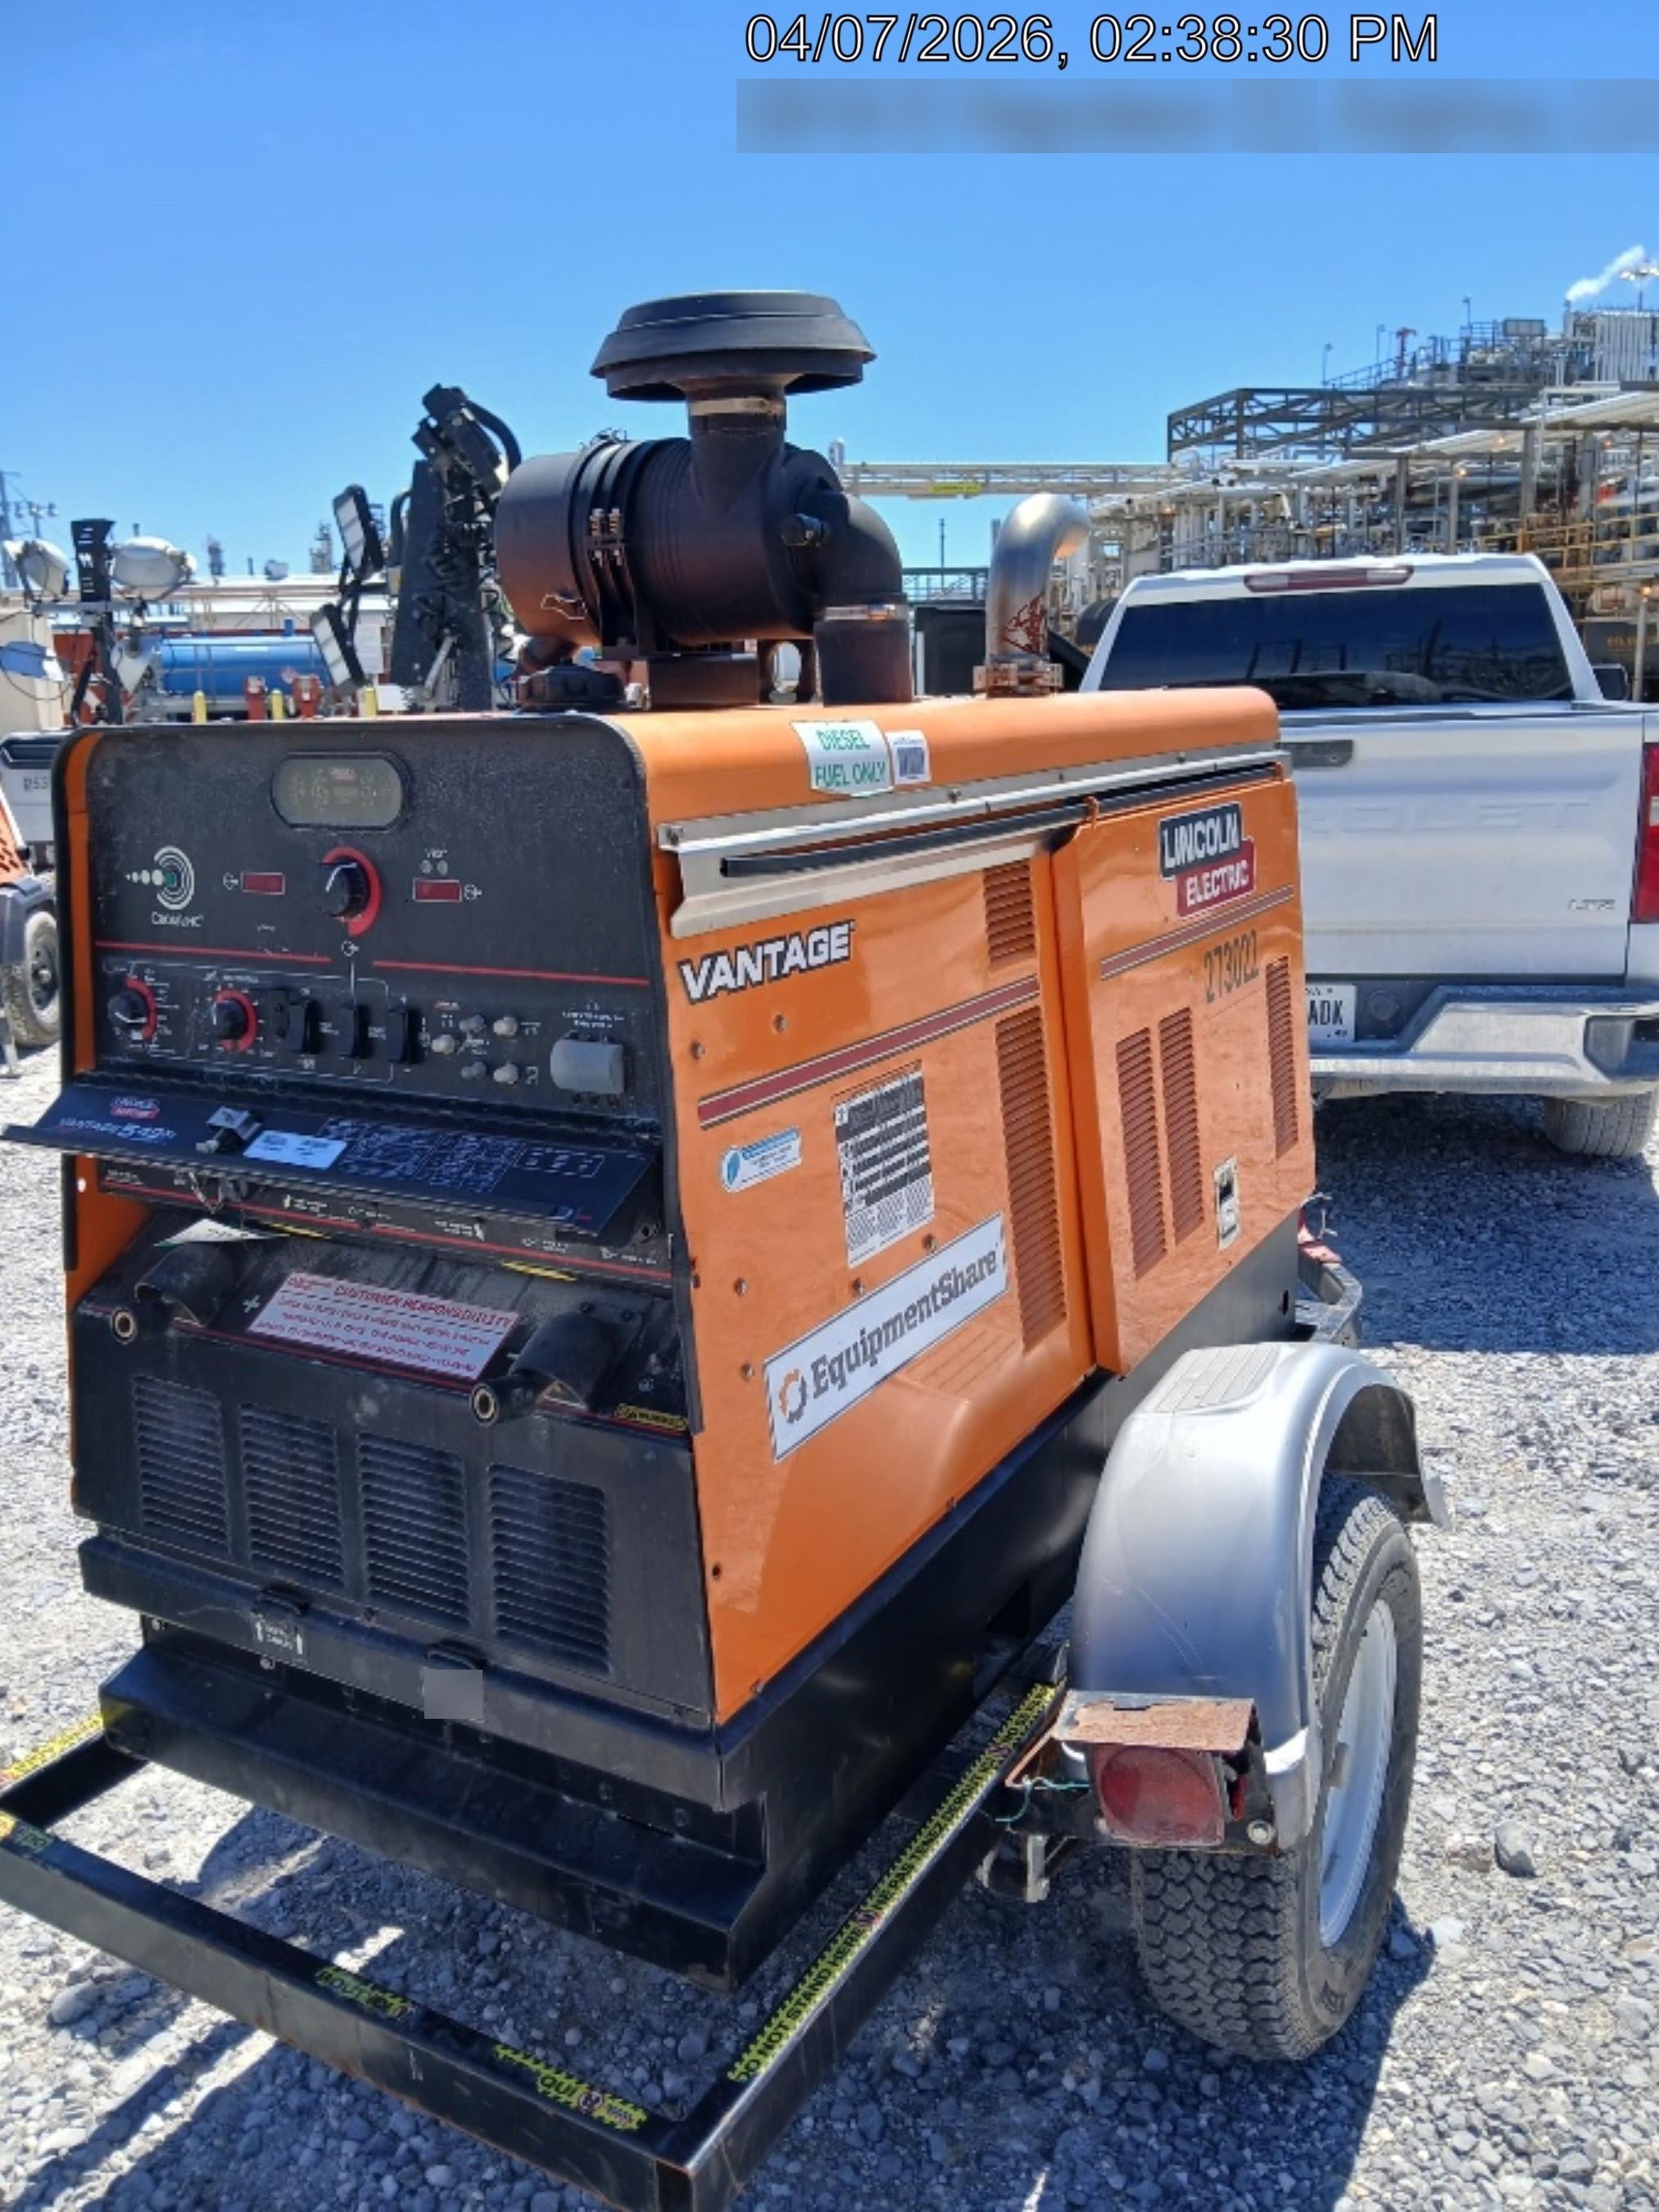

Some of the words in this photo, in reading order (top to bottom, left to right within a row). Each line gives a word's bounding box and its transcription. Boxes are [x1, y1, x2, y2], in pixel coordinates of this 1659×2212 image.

[815, 764, 851, 787] FUEL
[852, 761, 887, 784] ONLY
[1162, 812, 1240, 869] LINCOLN
[1185, 859, 1250, 907] ELECTRIC
[679, 920, 853, 1002] VANTAGE
[1203, 929, 1260, 1004] 273022
[810, 1249, 999, 1400] EquipmentShare
[756, 2019, 790, 2057] NOT
[786, 1968, 832, 2019] STAND
[827, 1926, 862, 1966] HERE
